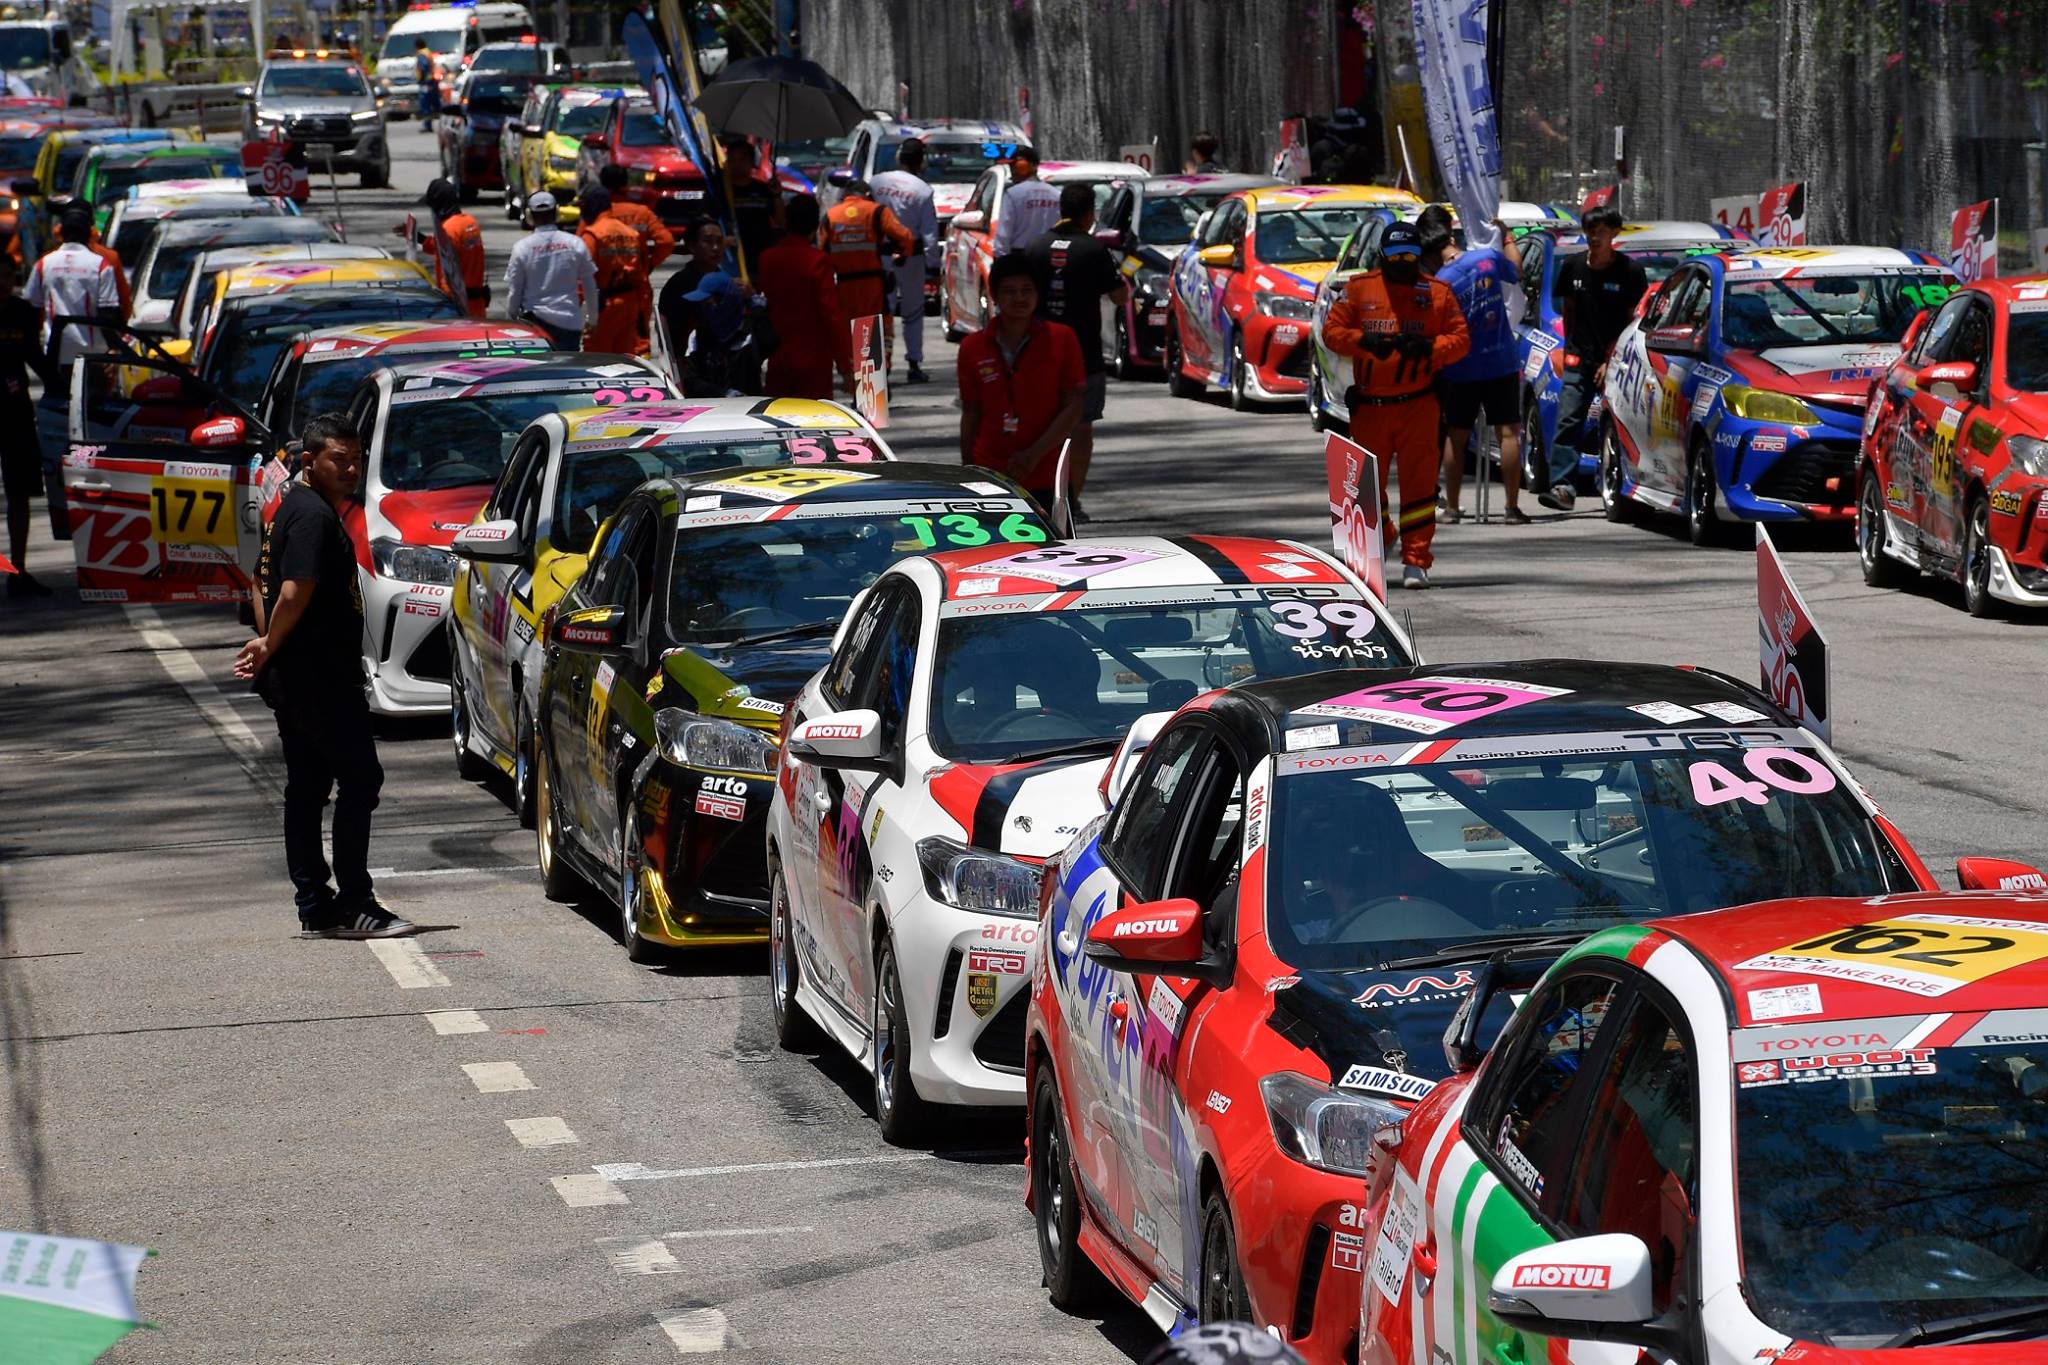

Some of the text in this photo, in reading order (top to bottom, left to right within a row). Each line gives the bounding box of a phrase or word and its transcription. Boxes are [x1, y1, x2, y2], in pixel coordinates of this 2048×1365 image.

[981, 143, 1018, 159] 37
[263, 163, 294, 193] 96
[1717, 207, 1754, 232] 14
[1770, 214, 1792, 247] 39
[532, 243, 569, 255] TOYOTA
[1961, 235, 1984, 282] 81
[1901, 284, 1962, 308] 18
[1275, 323, 1298, 334] arto
[1931, 367, 1967, 378] MOTUL
[568, 379, 650, 389] TRD
[762, 429, 855, 438] TRD
[575, 440, 630, 451] TOYOTA
[785, 438, 874, 464] 55
[181, 466, 220, 477] TOYOTA
[151, 487, 226, 534] 177
[795, 508, 909, 520] Racing Development
[906, 500, 1023, 513] TRD
[688, 513, 751, 525] TOYOTA
[466, 529, 506, 539] MOTUL
[899, 514, 1047, 547] 136
[1343, 497, 1370, 585] 39
[1010, 550, 1127, 568] 39
[1032, 571, 1071, 585] RACE
[82, 589, 128, 600] SAMSUNG
[409, 585, 445, 597] arto
[1214, 587, 1339, 601] TRD
[405, 605, 439, 616] TRD
[954, 602, 1028, 613] TOYOTA
[1080, 596, 1216, 609] Racing Development
[1270, 601, 1376, 639] 39
[563, 627, 609, 641] MOTUL
[1772, 648, 1806, 721] 40
[1363, 686, 1509, 712] 40
[1301, 707, 1438, 733] ONE MAKE RACE
[807, 726, 860, 738] MOTUL
[1623, 731, 1785, 750] TRD
[1294, 753, 1390, 769] TOYOTA
[1455, 745, 1628, 760] Racing Development
[702, 775, 748, 796] arto
[1688, 748, 1836, 806] 40
[698, 799, 741, 818] TRD
[1249, 785, 1268, 821] arto
[2000, 873, 2047, 890] MOTUL
[981, 923, 1037, 944] arto
[1113, 919, 1179, 937] MOTUL
[970, 945, 1027, 956] Racing Development
[1790, 924, 2016, 968] 162
[971, 955, 1023, 974] TRD
[1749, 960, 1944, 993] ONE MAKE RACE
[1158, 992, 1178, 1026] TOYOTA
[1757, 1033, 1888, 1053] TOYOTA
[1783, 1048, 1936, 1071] WOOT
[1912, 1062, 1938, 1076] 3
[1345, 1068, 1434, 1098] SAMSUN
[1336, 1233, 1357, 1245] Racing
[1516, 1266, 1607, 1287] MOTUL
